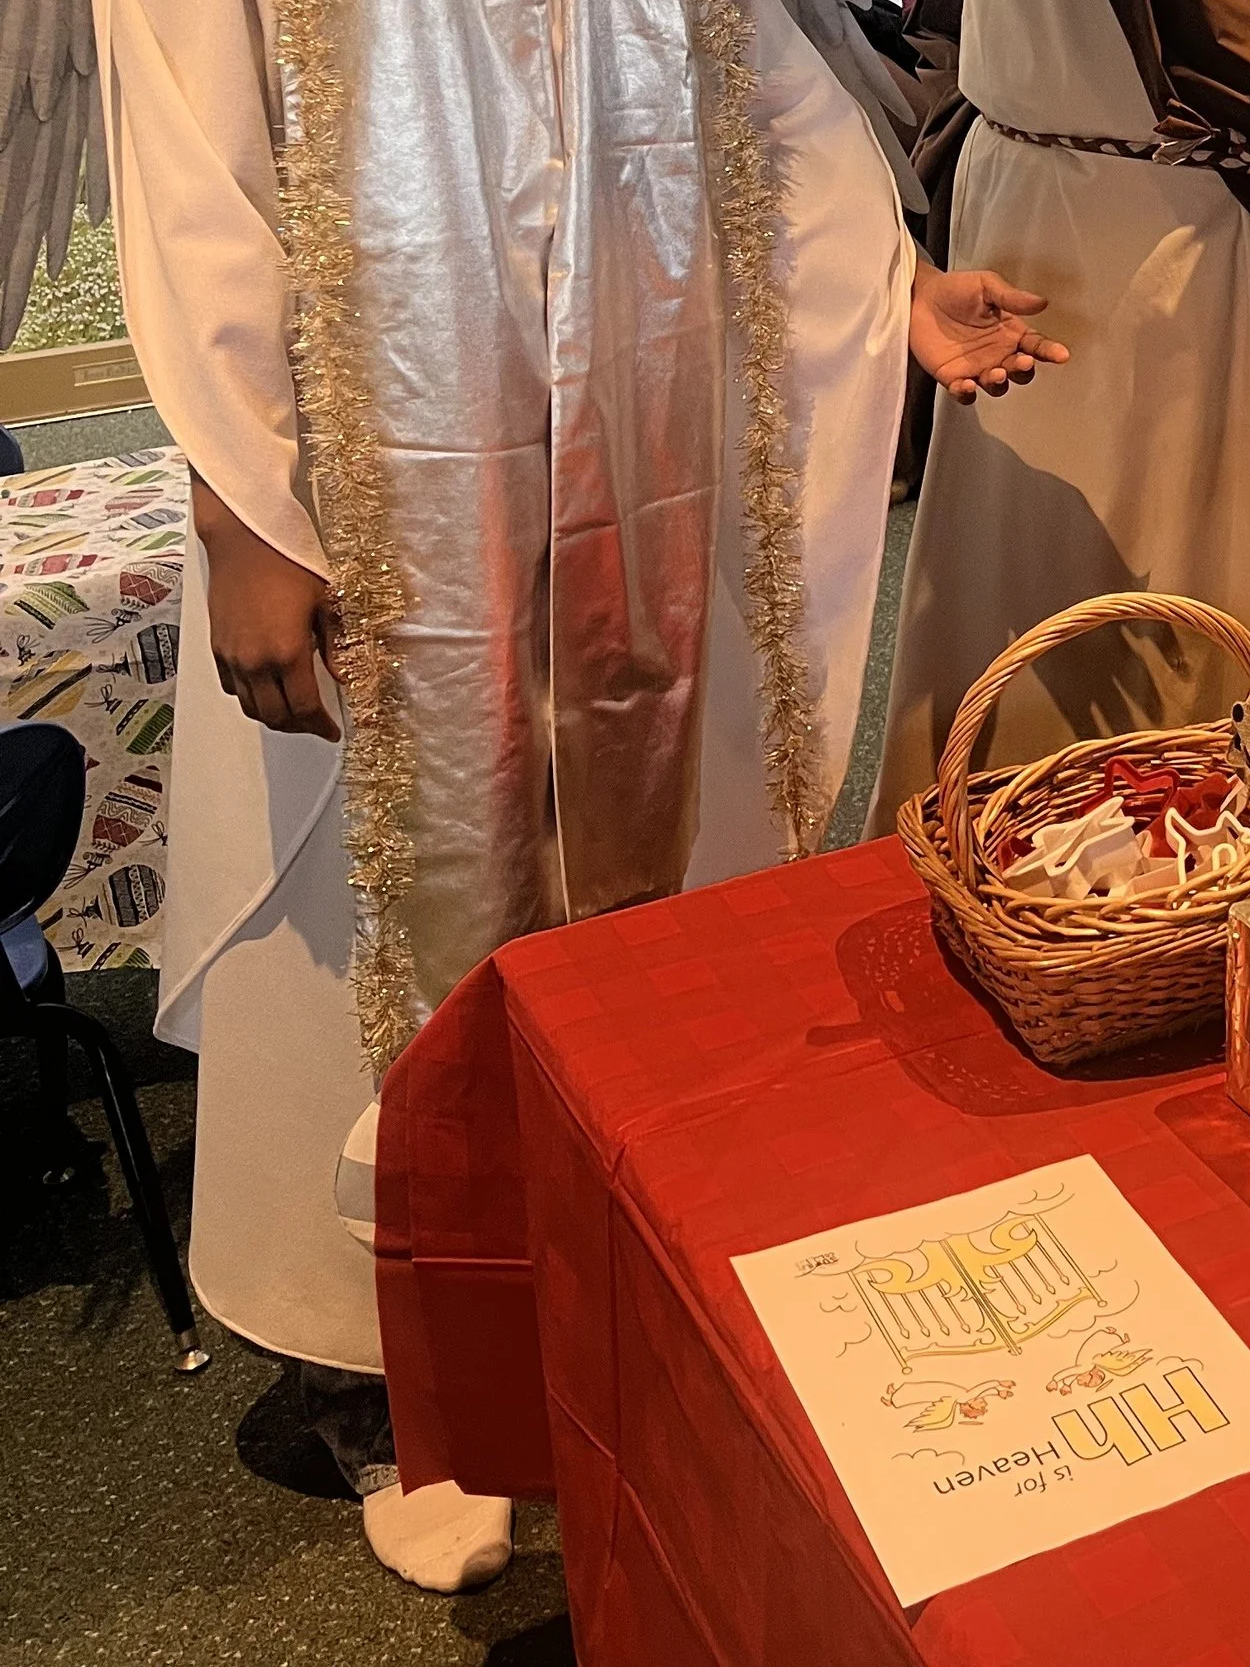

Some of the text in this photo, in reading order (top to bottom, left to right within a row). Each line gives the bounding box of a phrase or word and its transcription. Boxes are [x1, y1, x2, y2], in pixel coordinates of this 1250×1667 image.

[1051, 1366, 1230, 1466] Hh
[933, 1441, 1060, 1494] Heaven
[1014, 1465, 1074, 1497] is for
